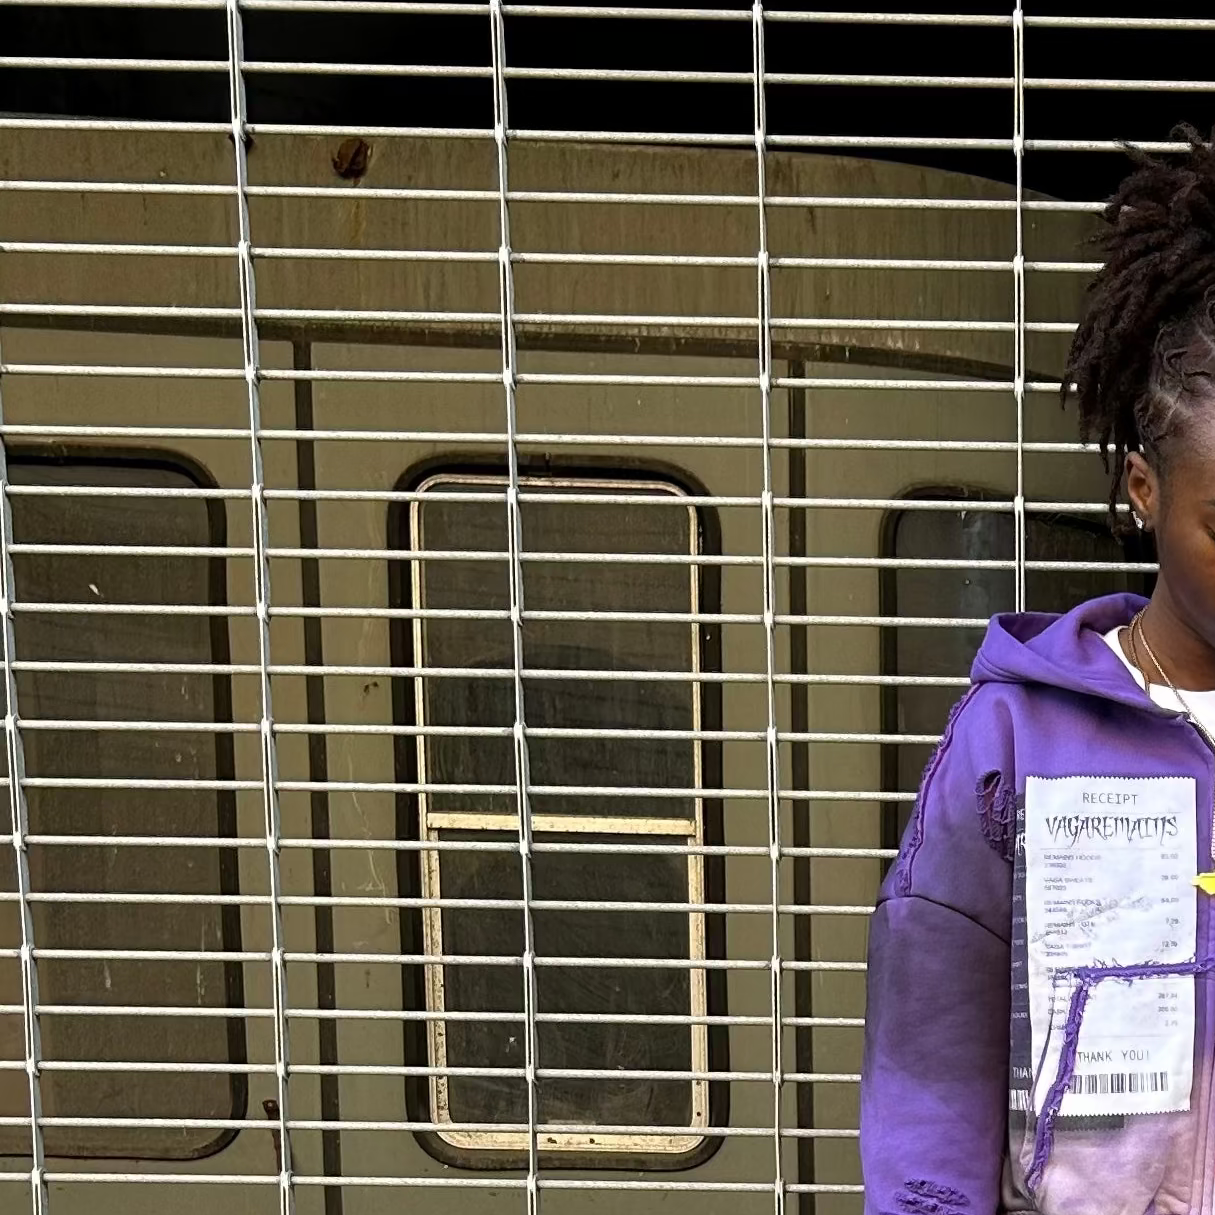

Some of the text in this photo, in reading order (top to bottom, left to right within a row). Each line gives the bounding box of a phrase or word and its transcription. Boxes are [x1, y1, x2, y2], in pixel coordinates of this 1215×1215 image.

[1082, 792, 1138, 806] RECEIPT
[1077, 1049, 1150, 1063] THANK YOU!
